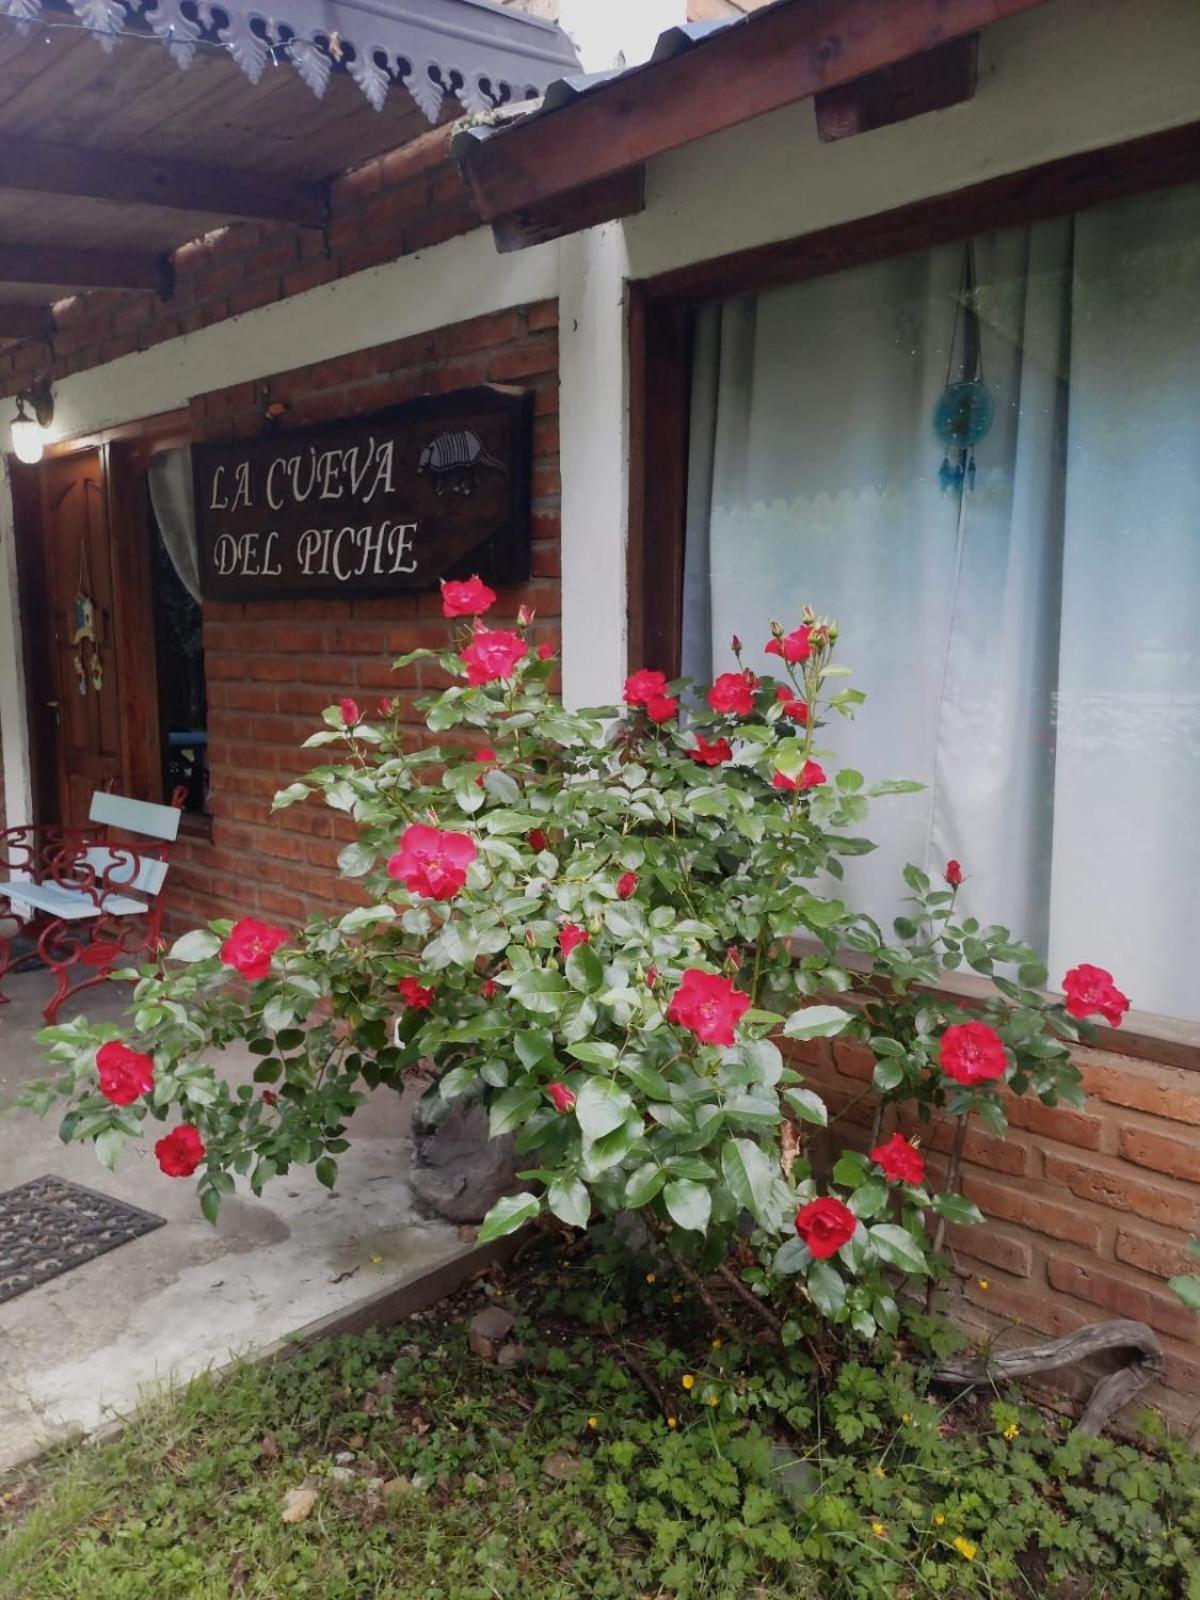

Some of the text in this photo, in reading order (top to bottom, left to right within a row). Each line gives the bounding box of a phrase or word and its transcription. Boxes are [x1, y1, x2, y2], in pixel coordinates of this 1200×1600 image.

[210, 437, 395, 512] LA CUEVA
[214, 521, 418, 581] DEL PICHE
